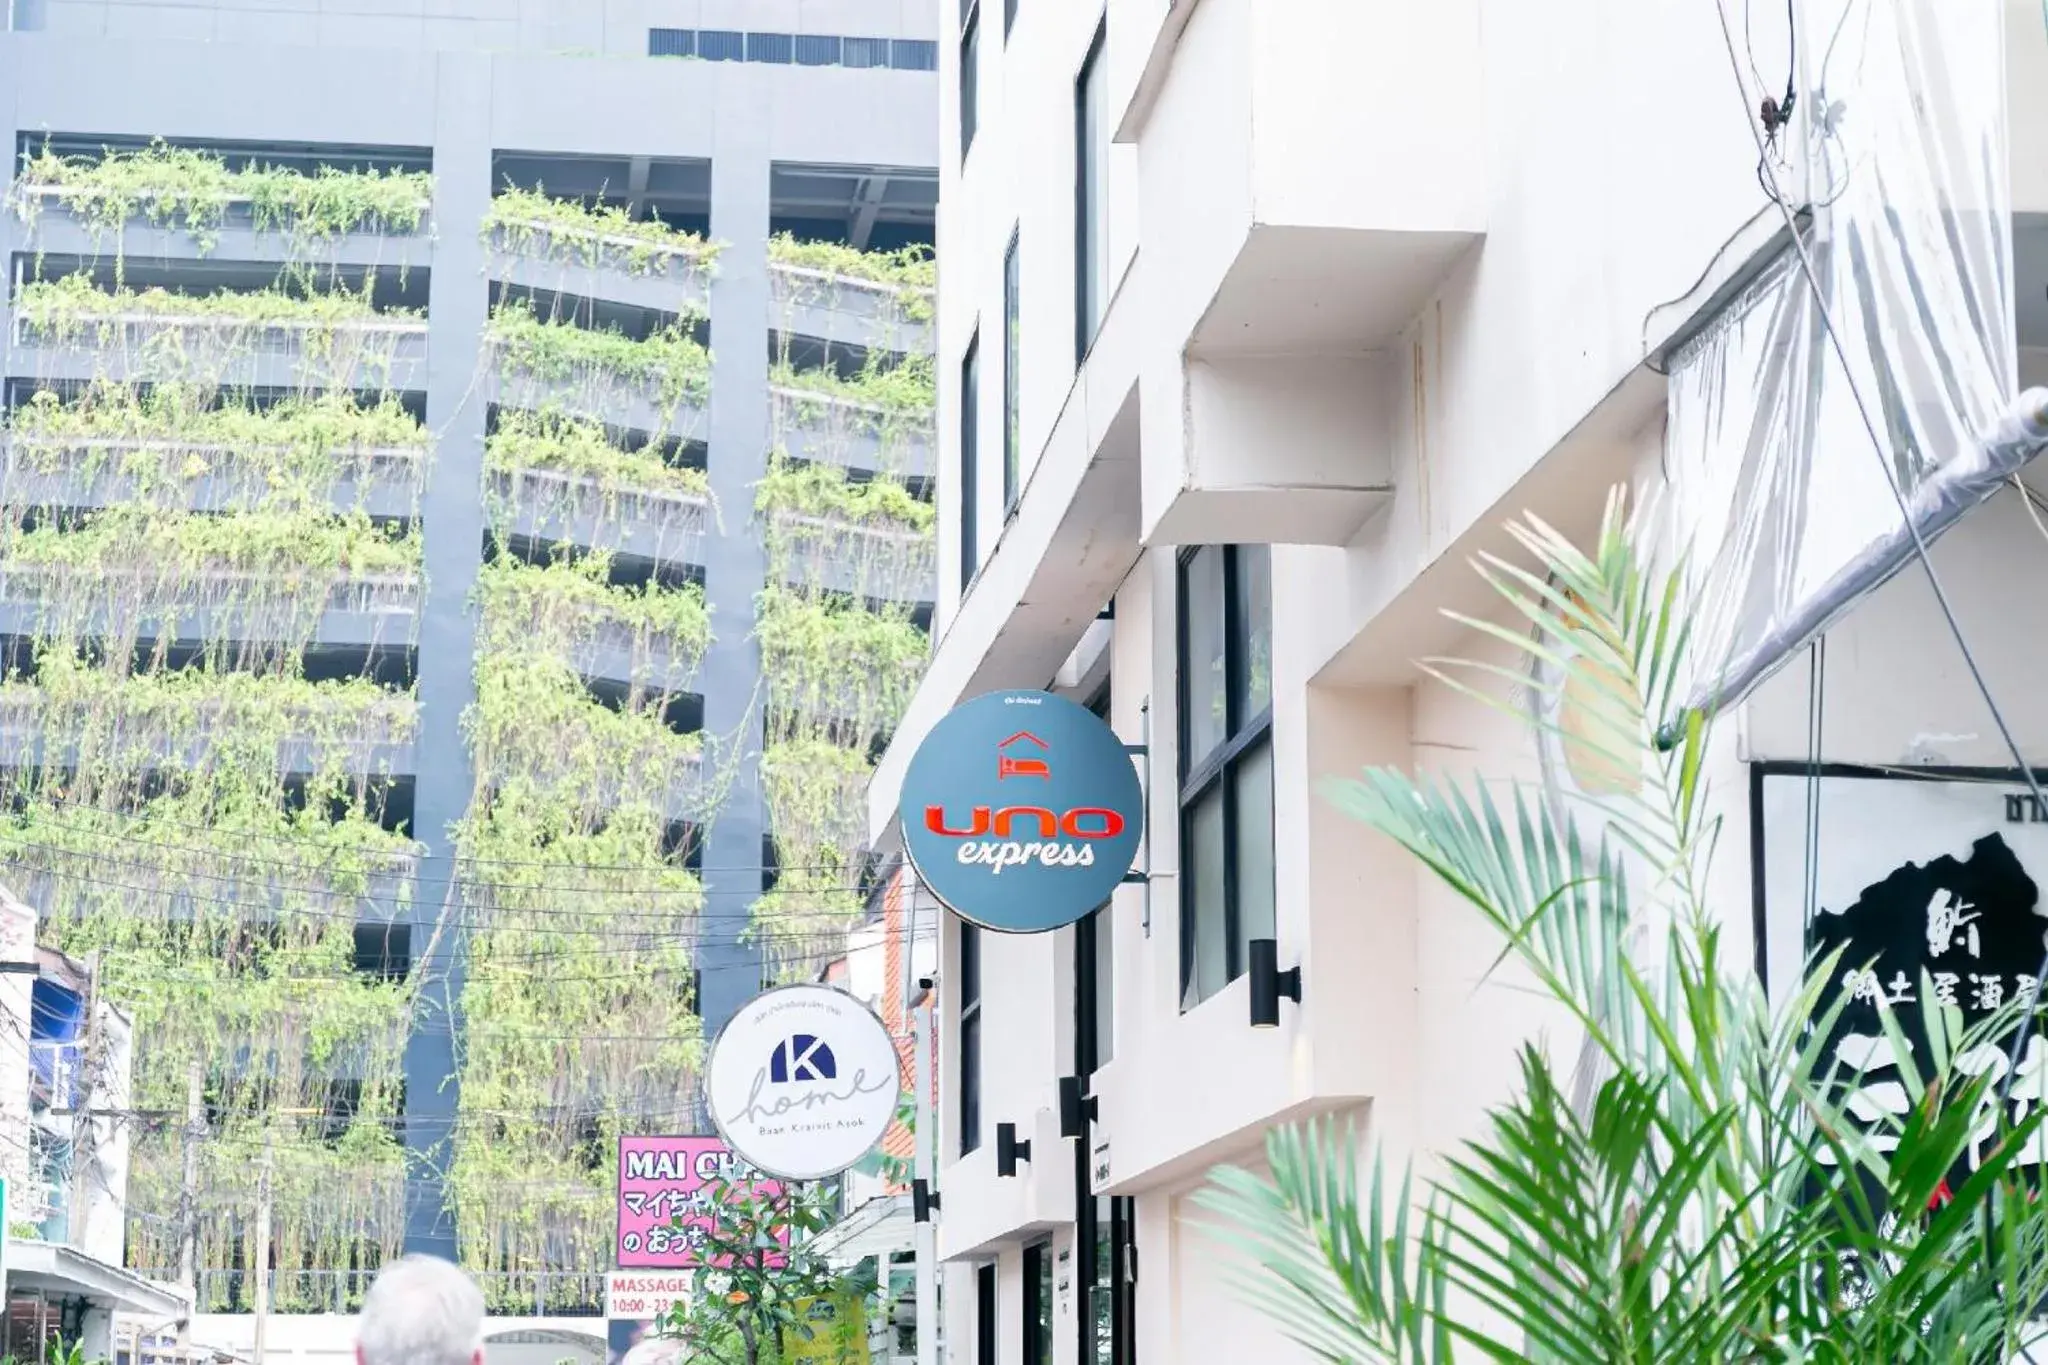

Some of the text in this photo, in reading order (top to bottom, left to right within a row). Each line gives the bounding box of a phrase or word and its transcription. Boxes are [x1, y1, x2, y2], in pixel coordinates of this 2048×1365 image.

[957, 840, 1095, 875] express
[727, 1066, 891, 1125] home
[837, 1116, 865, 1129] Asok
[625, 1150, 688, 1181] MAI
[612, 1278, 687, 1292] MASSAGE
[612, 1299, 645, 1312] 10:00
